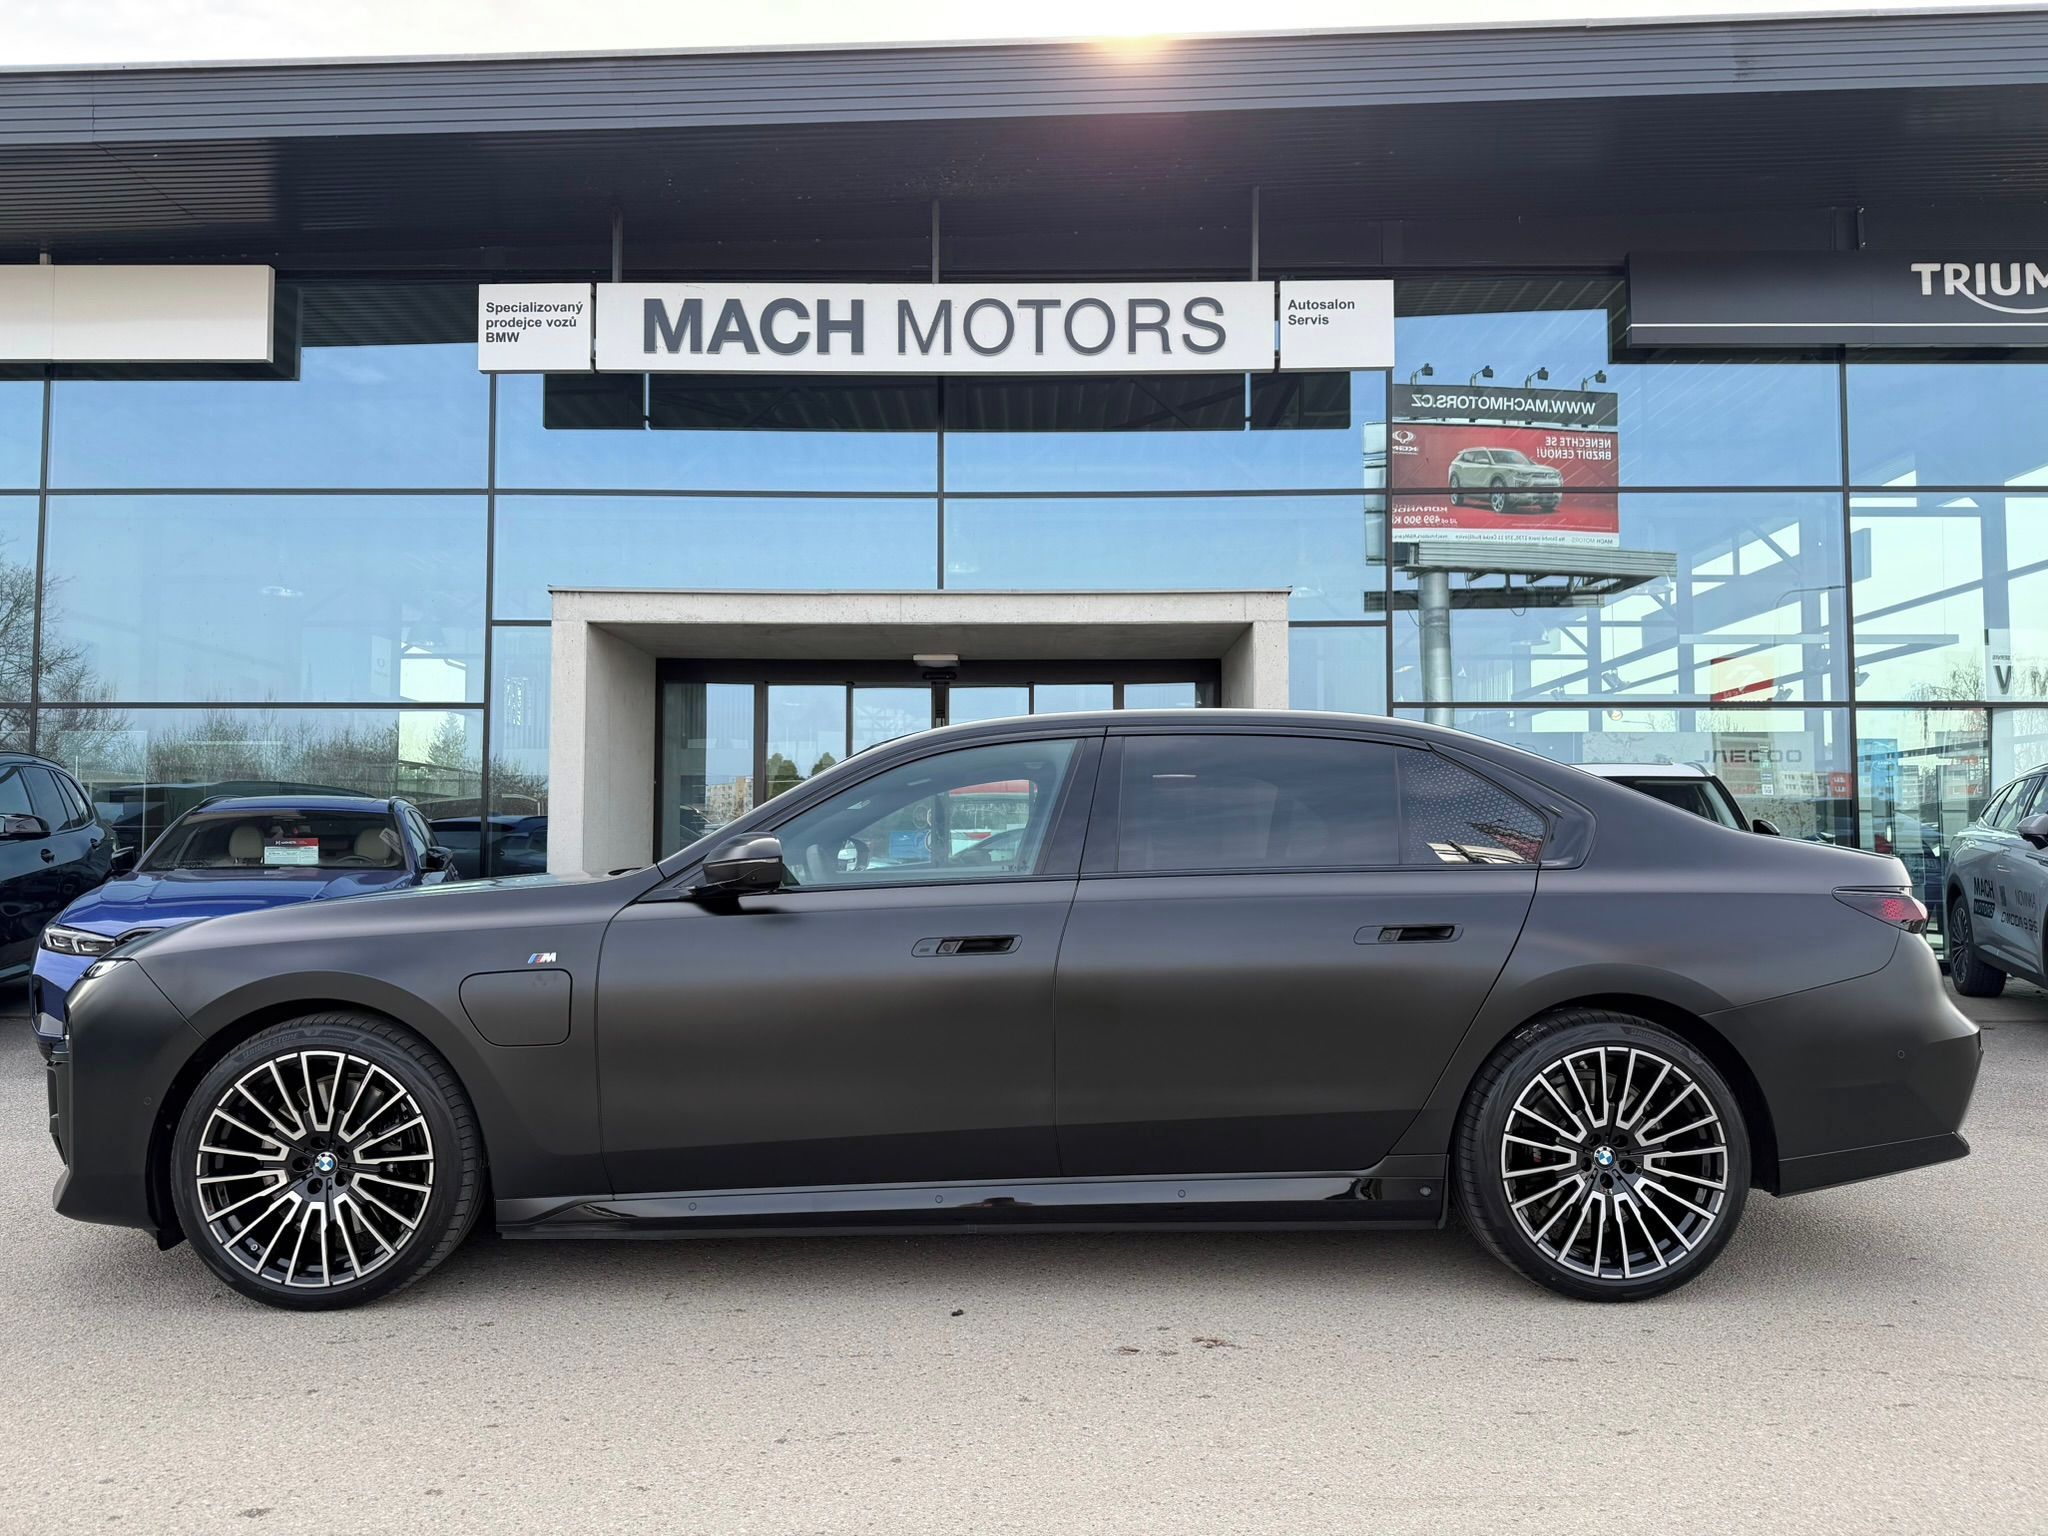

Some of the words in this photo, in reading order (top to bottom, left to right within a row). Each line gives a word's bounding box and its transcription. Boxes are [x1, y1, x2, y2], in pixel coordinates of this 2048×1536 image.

[486, 301, 583, 315] Specializovaný
[1288, 299, 1355, 310] Autosalon
[486, 317, 542, 330] prodejce
[546, 316, 577, 328] vozů
[642, 298, 866, 355] MACH
[898, 297, 1227, 356] MOTORS
[1288, 314, 1330, 325] Servis
[486, 332, 520, 343] BMW
[1974, 877, 1994, 899] MACH
